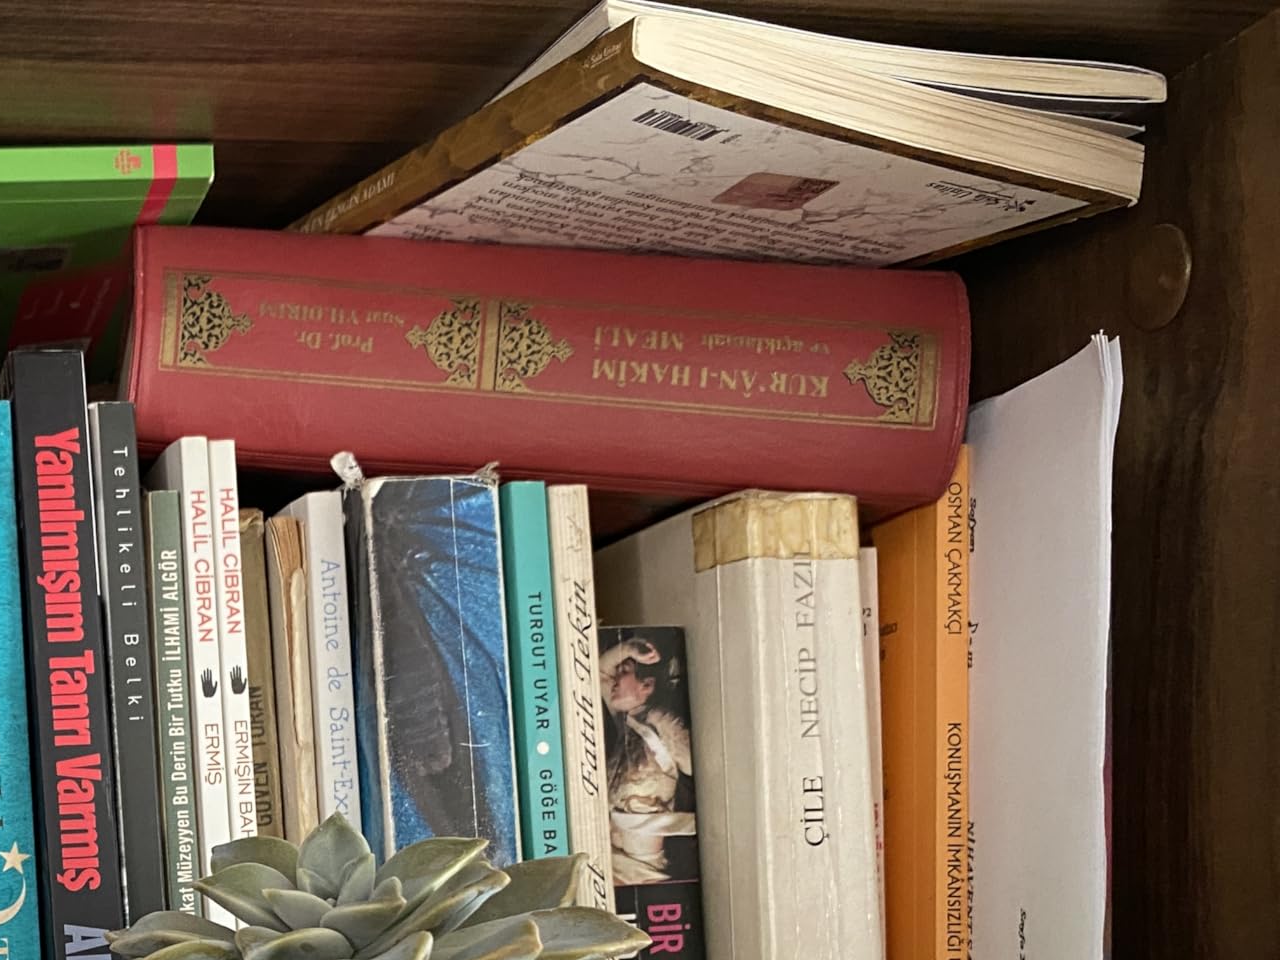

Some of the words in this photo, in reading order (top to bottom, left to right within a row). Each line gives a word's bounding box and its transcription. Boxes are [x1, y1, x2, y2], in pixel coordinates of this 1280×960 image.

[34, 427, 85, 643] Yanılmışım
[113, 446, 137, 607] Tehlikeli
[190, 490, 212, 553] HALİL
[219, 488, 238, 548] HALİL
[947, 481, 963, 544] OSMAN
[158, 549, 179, 602] ALGÖR
[194, 558, 215, 643] CİBRAN
[223, 553, 242, 635] CİBRAN
[320, 559, 342, 652] Antoine
[792, 540, 815, 632] FAZIL
[944, 549, 963, 635] ÇAKMAKÇI
[159, 607, 182, 662] İLHAMİ
[527, 591, 546, 671] TURGUT
[567, 579, 593, 682] Tekin
[48, 650, 96, 747] Tanrı
[124, 633, 144, 721] Belki
[166, 668, 185, 711] Tutku
[327, 666, 348, 693] de
[533, 678, 550, 731] UYAR
[794, 647, 822, 739] NECİP
[168, 714, 186, 737] Bir
[169, 741, 188, 782] Derin
[204, 723, 225, 786] ERMİŞ
[234, 720, 255, 795] ERMİŞİN
[328, 707, 353, 815] Saint-Ex
[572, 689, 599, 797] Fatih
[172, 786, 189, 806] Bu
[539, 769, 559, 821] GÖĞE
[799, 776, 830, 847] ÇİLE
[944, 722, 963, 838] KONUŞMANIN
[55, 753, 103, 892] Varmış
[176, 810, 194, 883] Müzeyyen
[238, 801, 256, 838] BAH
[542, 830, 557, 855] BA
[178, 888, 195, 915] kat
[647, 904, 691, 954] BİR
